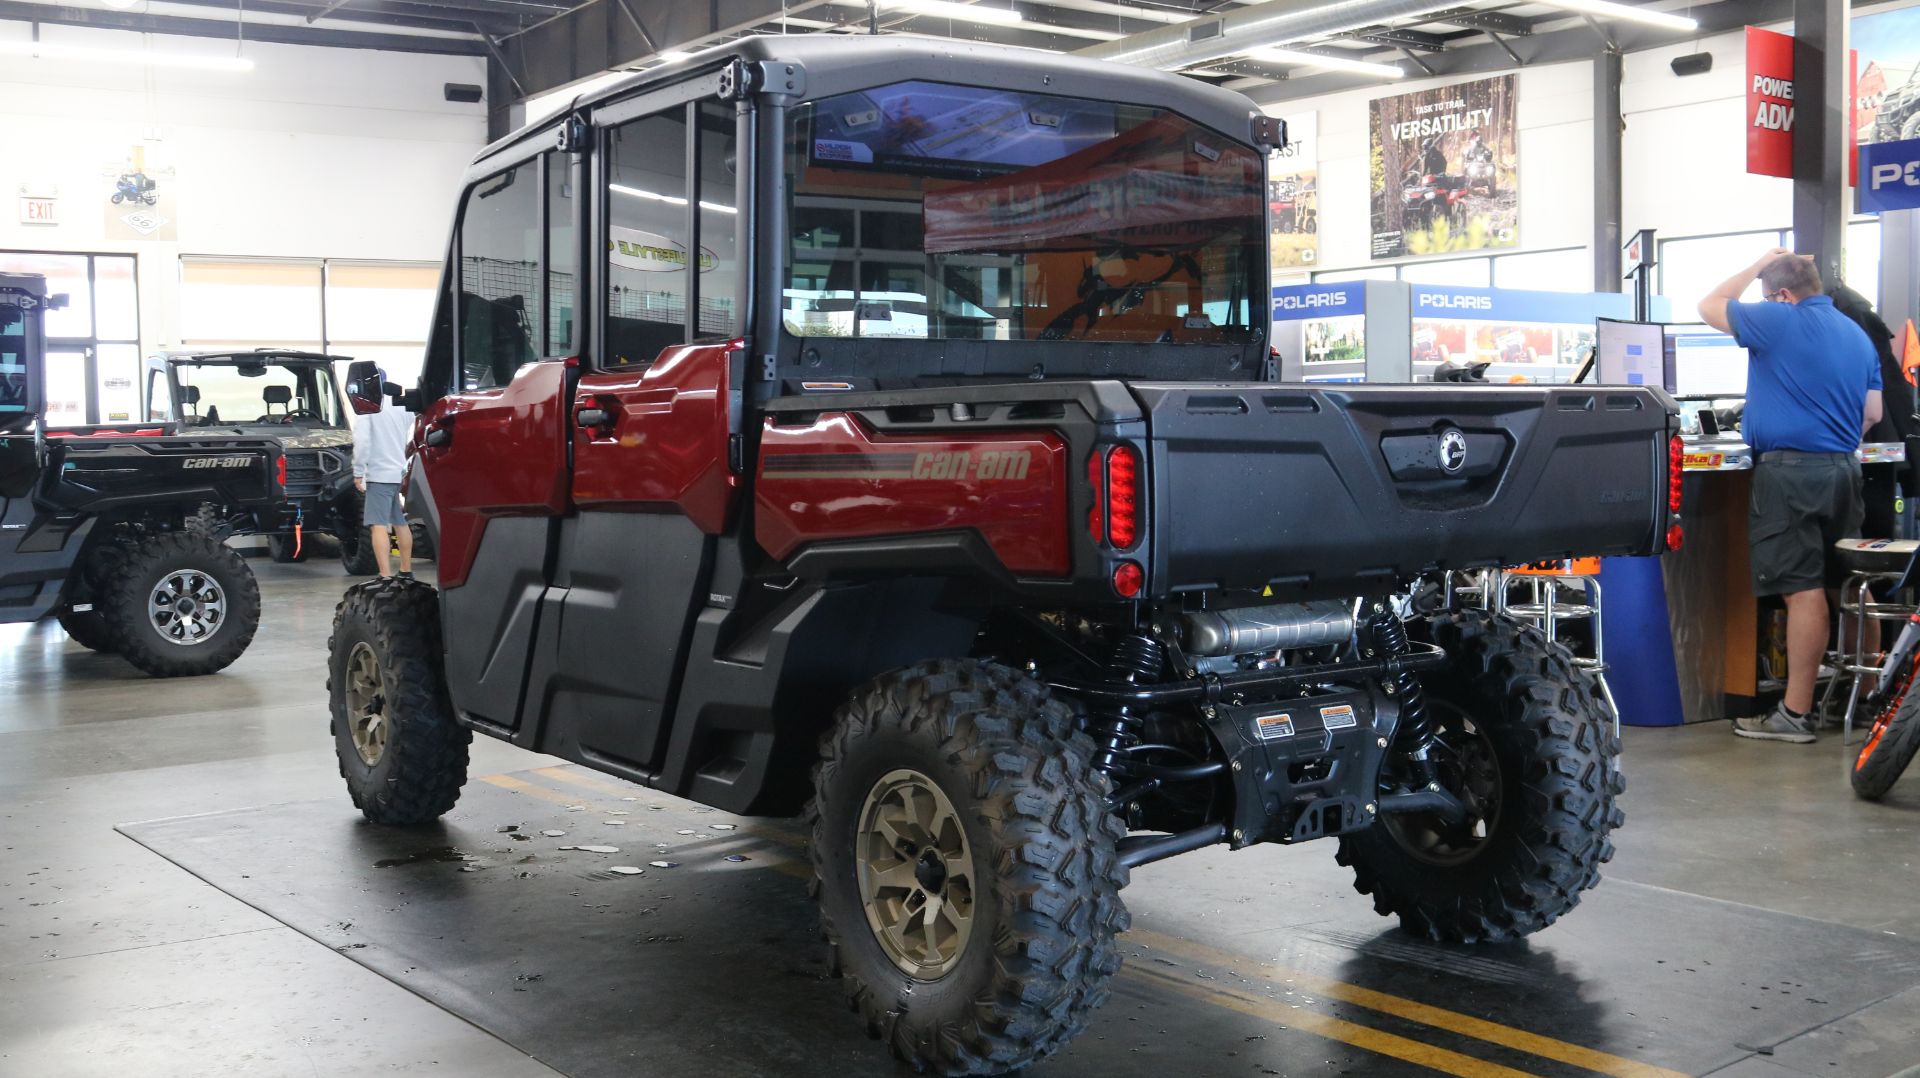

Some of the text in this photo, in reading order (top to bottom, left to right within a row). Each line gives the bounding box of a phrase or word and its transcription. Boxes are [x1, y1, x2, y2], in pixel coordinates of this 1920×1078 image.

[1415, 99, 1466, 114] TASK TO TRAIL
[1391, 108, 1493, 140] VERSATILITY
[28, 202, 53, 219] EXIT
[1272, 291, 1346, 310] POLARIS
[1420, 293, 1492, 310] POLARIS
[182, 457, 251, 469] can-am
[911, 451, 1031, 480] can-am
